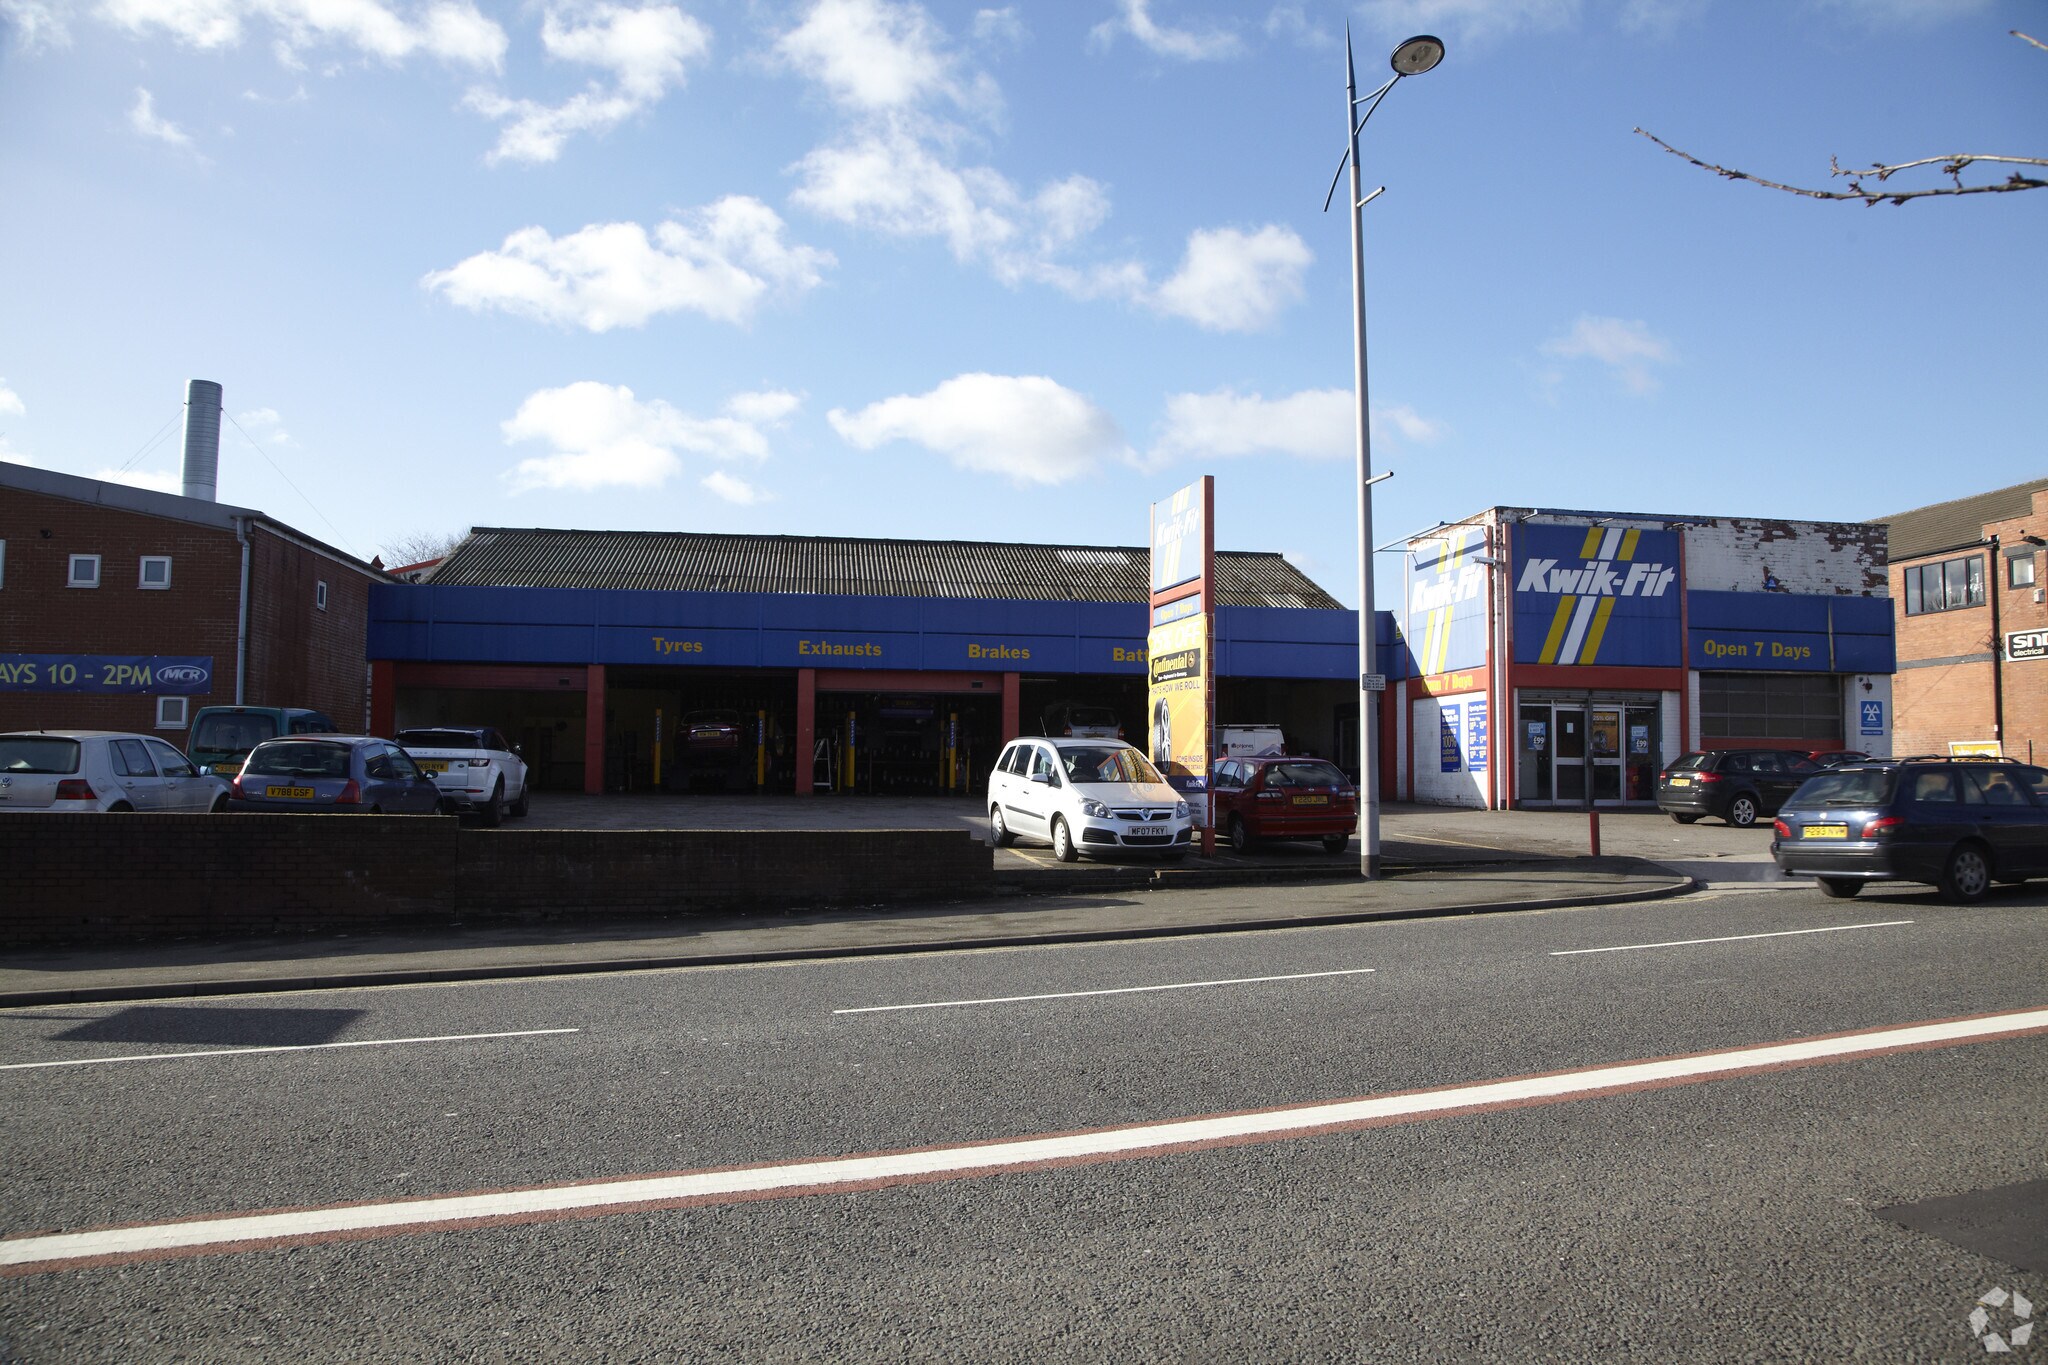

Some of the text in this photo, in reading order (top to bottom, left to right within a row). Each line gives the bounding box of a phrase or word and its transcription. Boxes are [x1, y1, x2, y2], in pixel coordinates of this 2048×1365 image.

[1516, 558, 1676, 597] Kwik-Fit
[1410, 564, 1484, 614] Kwik-Fit
[652, 637, 703, 654] Tyres
[799, 640, 882, 656] Exhausts
[968, 643, 1031, 659] Brakes
[1703, 639, 1811, 660] Open 7 Days
[2013, 647, 2045, 657] electrical
[1153, 652, 1188, 678] Continental
[48, 663, 76, 685] 10
[102, 664, 152, 686] 2PM
[163, 668, 201, 682] MCR
[1175, 681, 1183, 692] WE
[1184, 679, 1201, 690] ROLL
[1422, 673, 1473, 694] Open 7 Days
[293, 787, 310, 797] GSF
[1131, 827, 1165, 835] MF07 FKY
